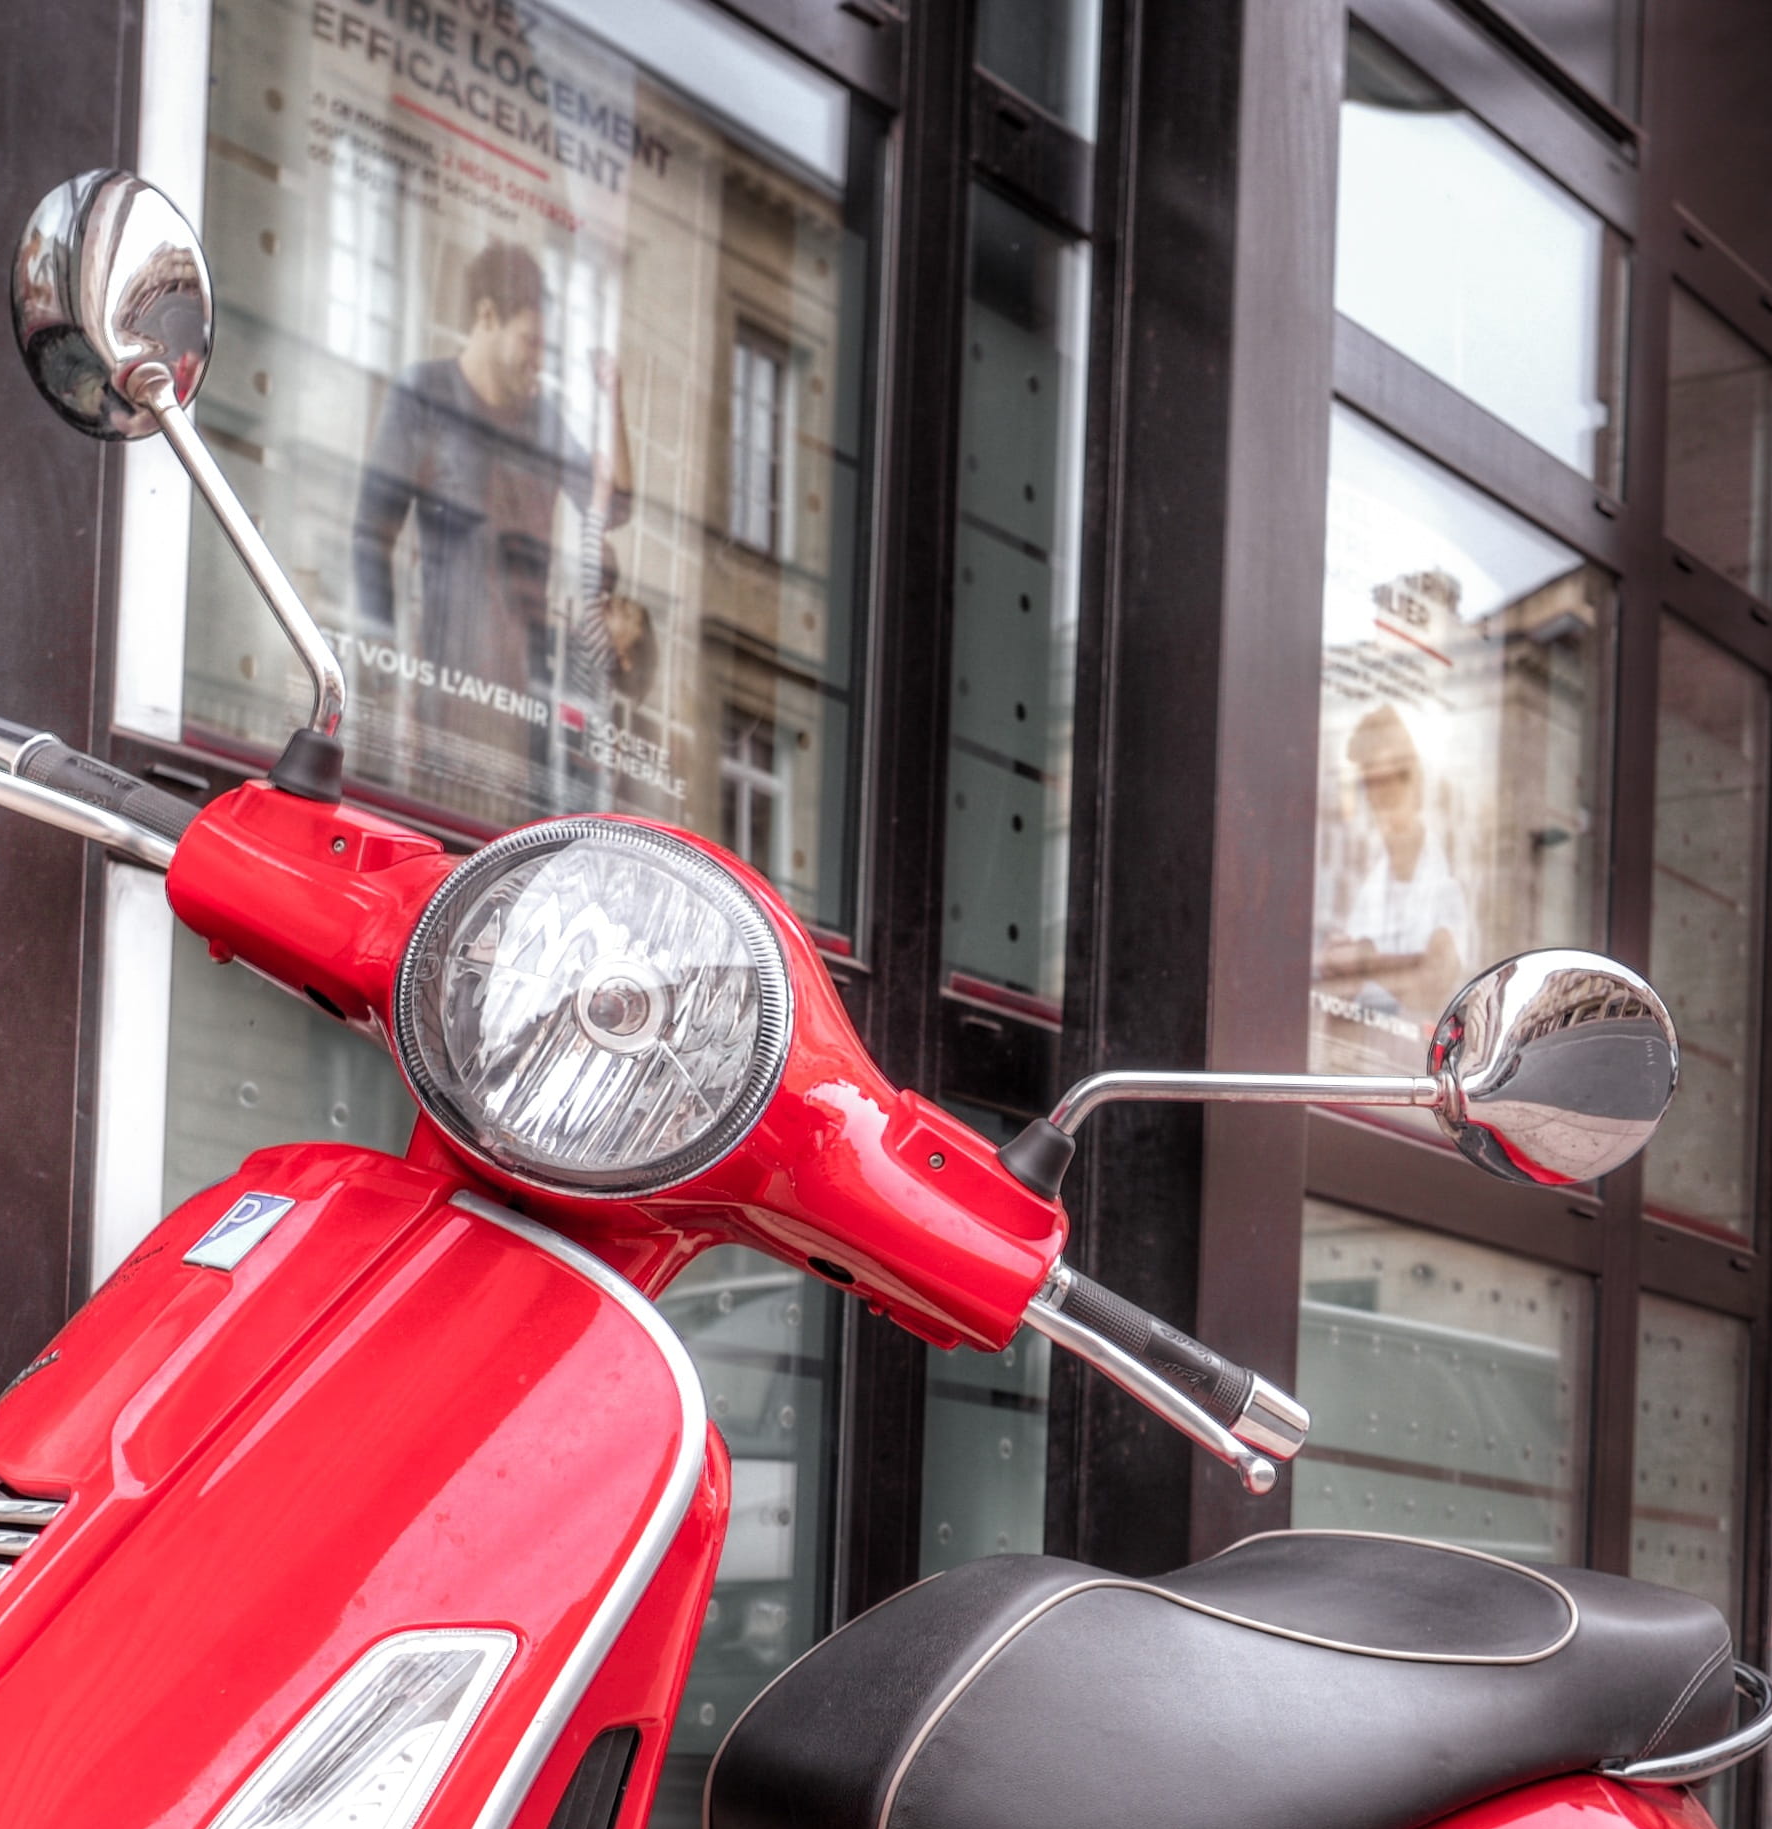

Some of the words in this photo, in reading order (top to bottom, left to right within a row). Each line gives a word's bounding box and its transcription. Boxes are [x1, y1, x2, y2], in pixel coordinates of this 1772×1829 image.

[312, 3, 625, 193] EFFICACEMENT
[471, 31, 673, 178] LOGEMENT
[356, 638, 435, 688] VOUS
[439, 667, 550, 728] L'AVENIR
[588, 715, 670, 771] SOCIETE
[589, 740, 687, 800] GENERALE
[209, 1199, 262, 1238] P
